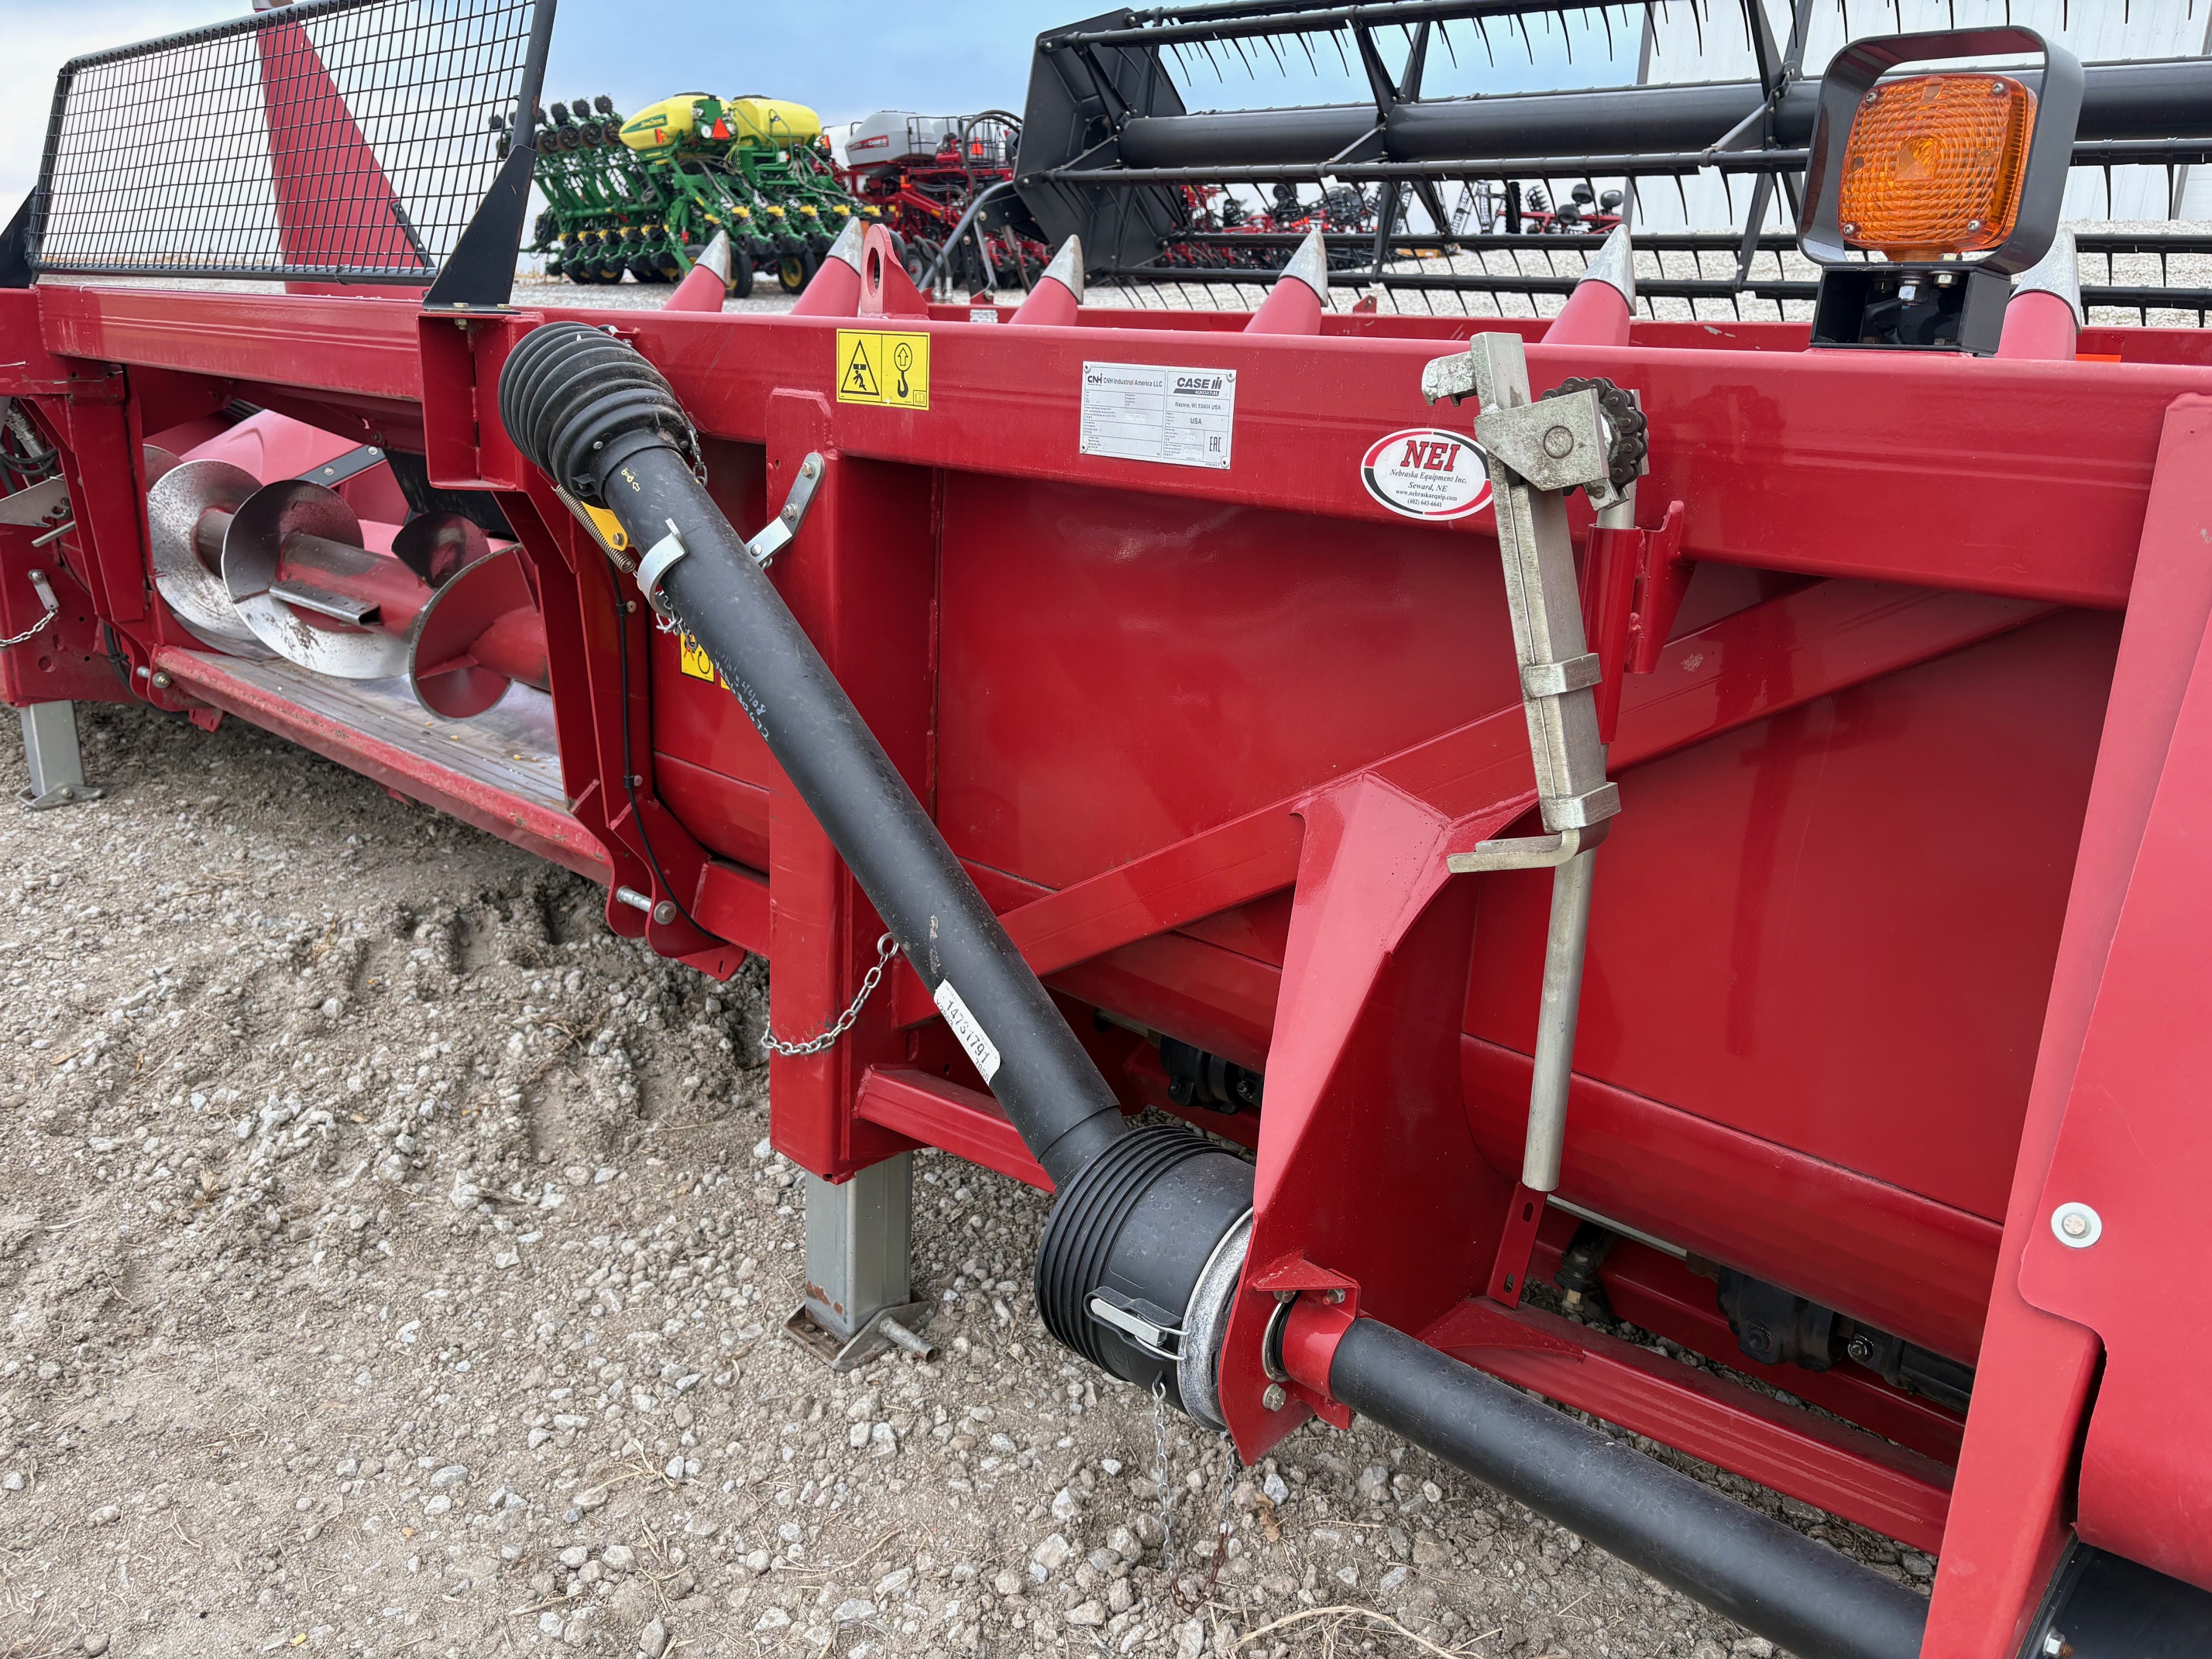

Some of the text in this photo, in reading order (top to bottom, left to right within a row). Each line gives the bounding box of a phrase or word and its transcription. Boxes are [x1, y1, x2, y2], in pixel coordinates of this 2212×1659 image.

[1176, 377, 1211, 389] CASE
[1209, 436, 1222, 452] EAC
[1400, 440, 1462, 472] NEI
[1389, 469, 1467, 484] Nebraska Equipment Inc.
[1407, 481, 1448, 493] Seward, NE
[1396, 489, 1458, 502] www.nebraskaequip.com
[1420, 500, 1442, 508] 643-6641
